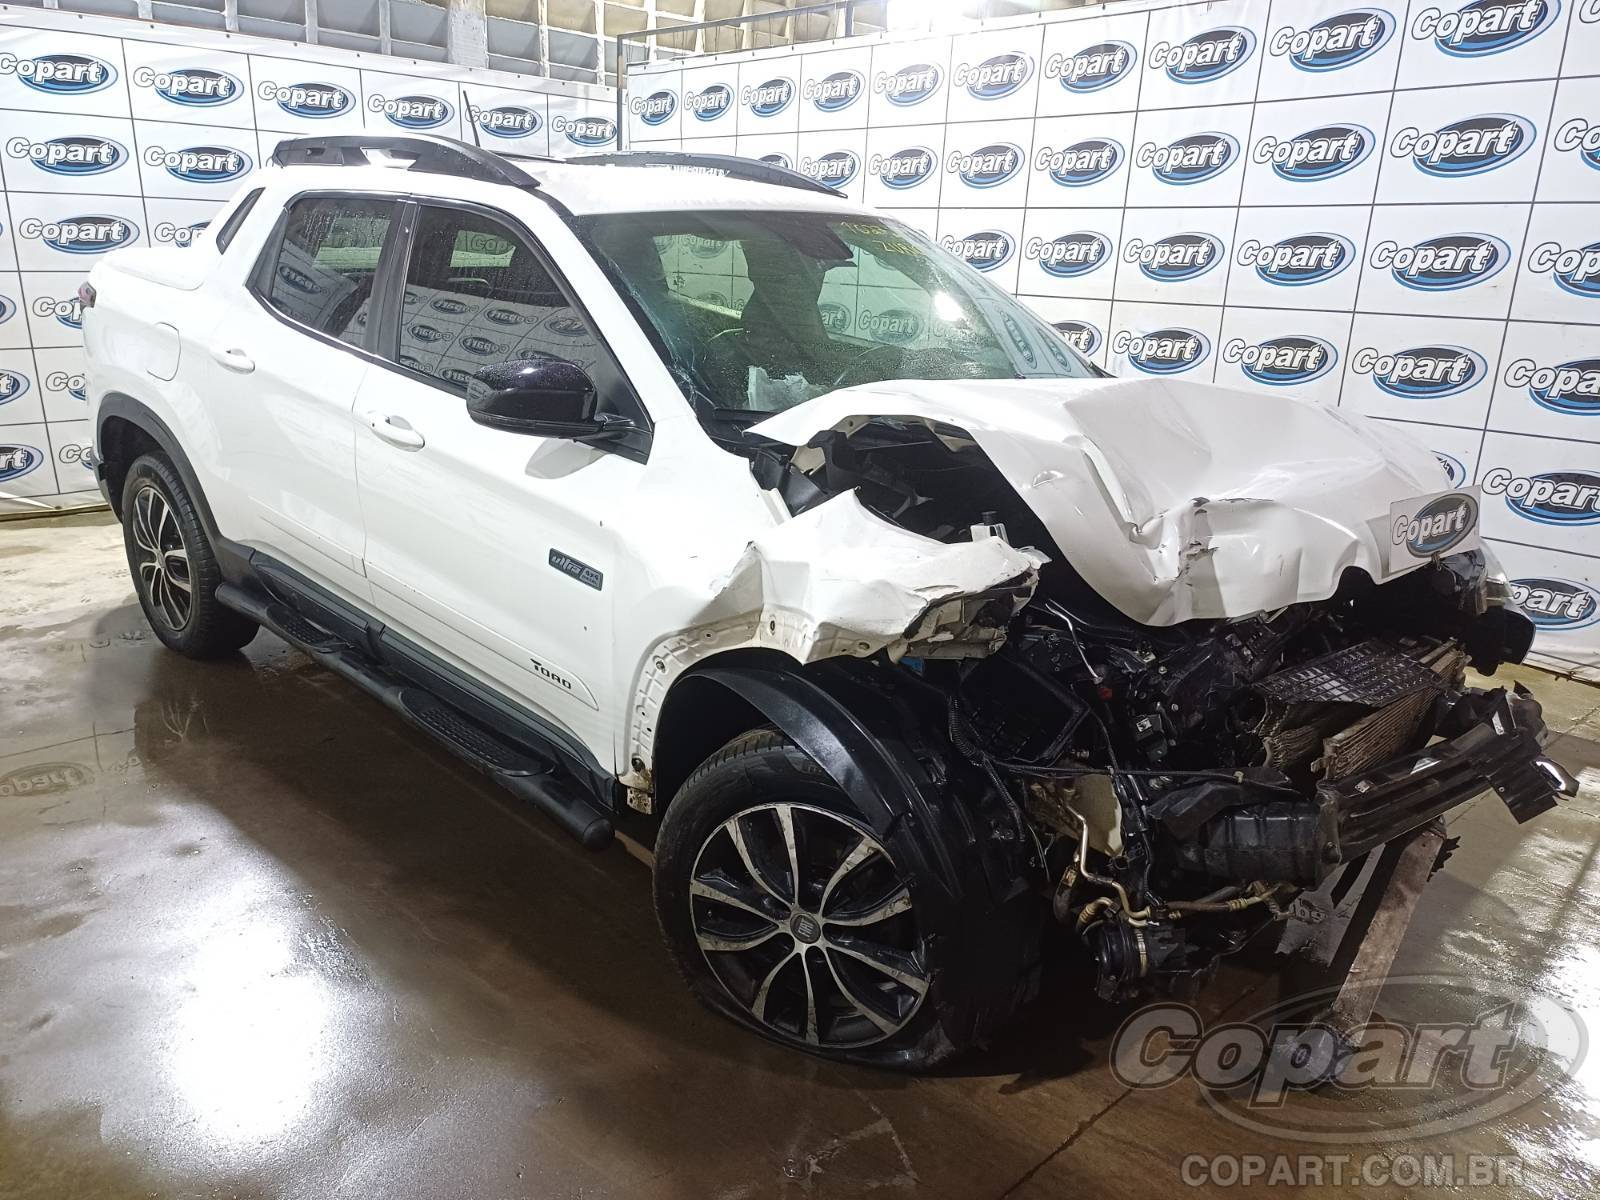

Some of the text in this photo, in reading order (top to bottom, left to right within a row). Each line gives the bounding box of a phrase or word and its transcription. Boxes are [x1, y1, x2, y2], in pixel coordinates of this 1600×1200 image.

[1270, 15, 1380, 61] Copart
[1411, 0, 1541, 46] Copart
[0, 52, 102, 84] Copart
[1045, 46, 1126, 83] Copart
[1149, 32, 1244, 74] Copart
[133, 67, 231, 97] Copart
[803, 74, 858, 100] Copart
[874, 65, 936, 95] Copart
[953, 57, 1025, 90] Copart
[258, 81, 345, 109] Copart
[368, 94, 444, 120] Copart
[631, 97, 672, 114] Copart
[684, 88, 727, 111] Copart
[741, 81, 790, 108] Copart
[465, 105, 533, 129] Copart
[552, 116, 615, 137] Copart
[6, 137, 116, 164] Copart
[1136, 138, 1227, 175] Copart
[1253, 130, 1360, 170] Copart
[1390, 120, 1517, 165] Copart
[144, 145, 239, 173] Copart
[801, 154, 852, 181] Copart
[869, 151, 931, 179] Copart
[946, 148, 1016, 179] Copart
[1035, 143, 1114, 176] Copart
[20, 218, 125, 245] Copart
[1025, 237, 1101, 264] Copart
[1124, 238, 1211, 270] Copart
[1237, 239, 1339, 273] Copart
[1370, 240, 1492, 278] Copart
[1528, 242, 1600, 282] Cop
[859, 309, 914, 335] Copart
[1113, 330, 1199, 360] Copart
[1223, 338, 1322, 371] Copart
[1352, 347, 1470, 384] Copart
[1504, 358, 1600, 399] Copa
[1392, 499, 1467, 547] Copart
[1511, 582, 1591, 619] part
